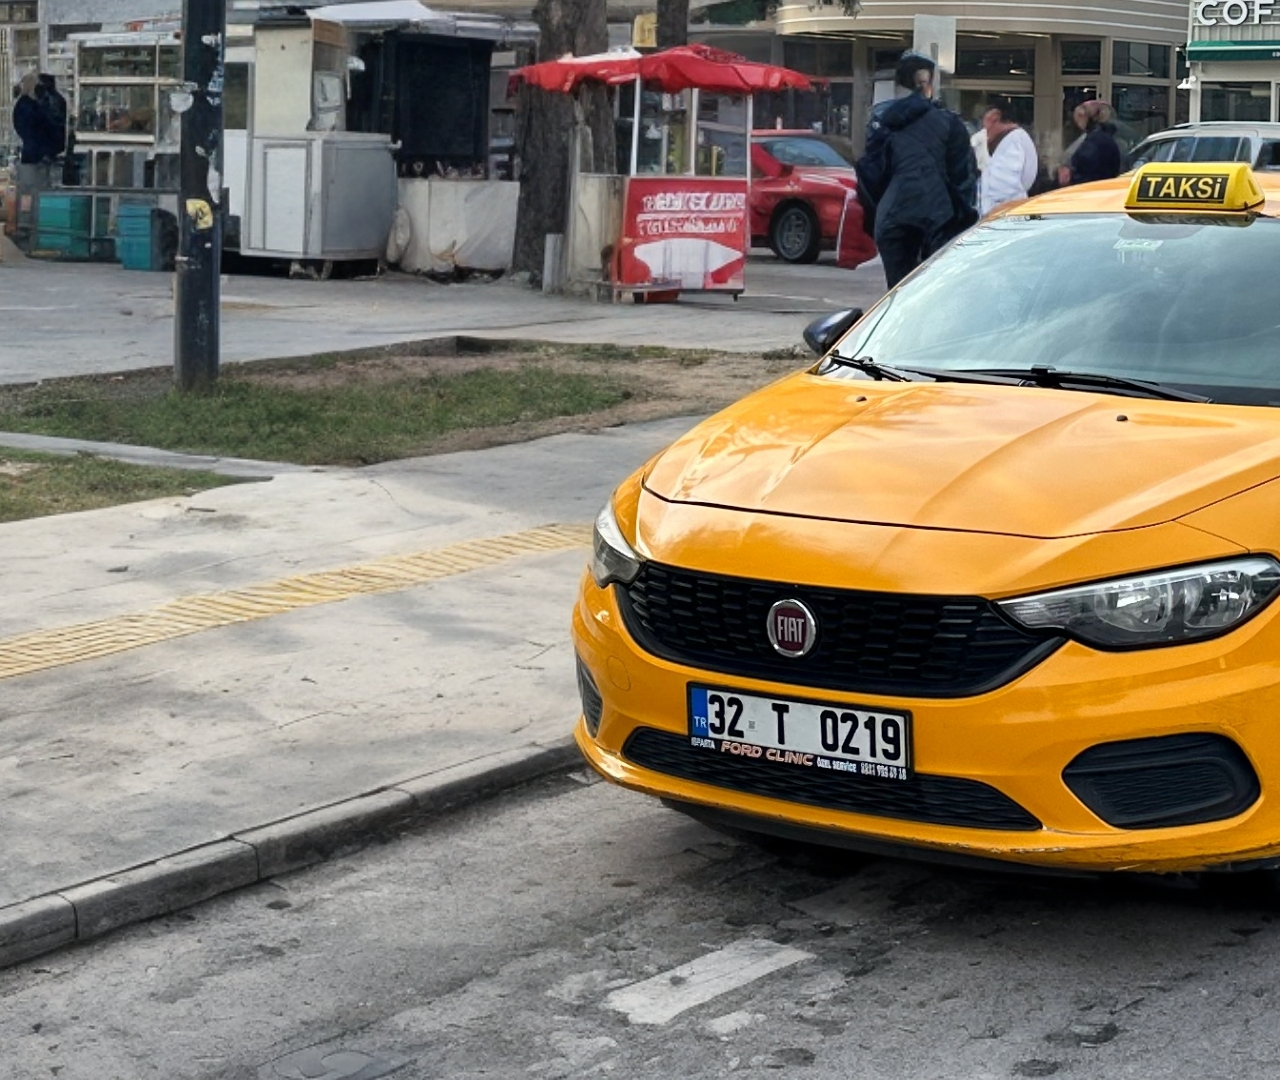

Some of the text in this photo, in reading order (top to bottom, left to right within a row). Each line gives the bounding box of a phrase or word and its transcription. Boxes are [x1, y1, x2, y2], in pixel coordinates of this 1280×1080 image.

[777, 615, 805, 644] FIAT
[694, 716, 708, 729] TR
[708, 693, 902, 762] 32 T 0219
[720, 740, 763, 759] FORD
[765, 748, 814, 767] CLINIC
